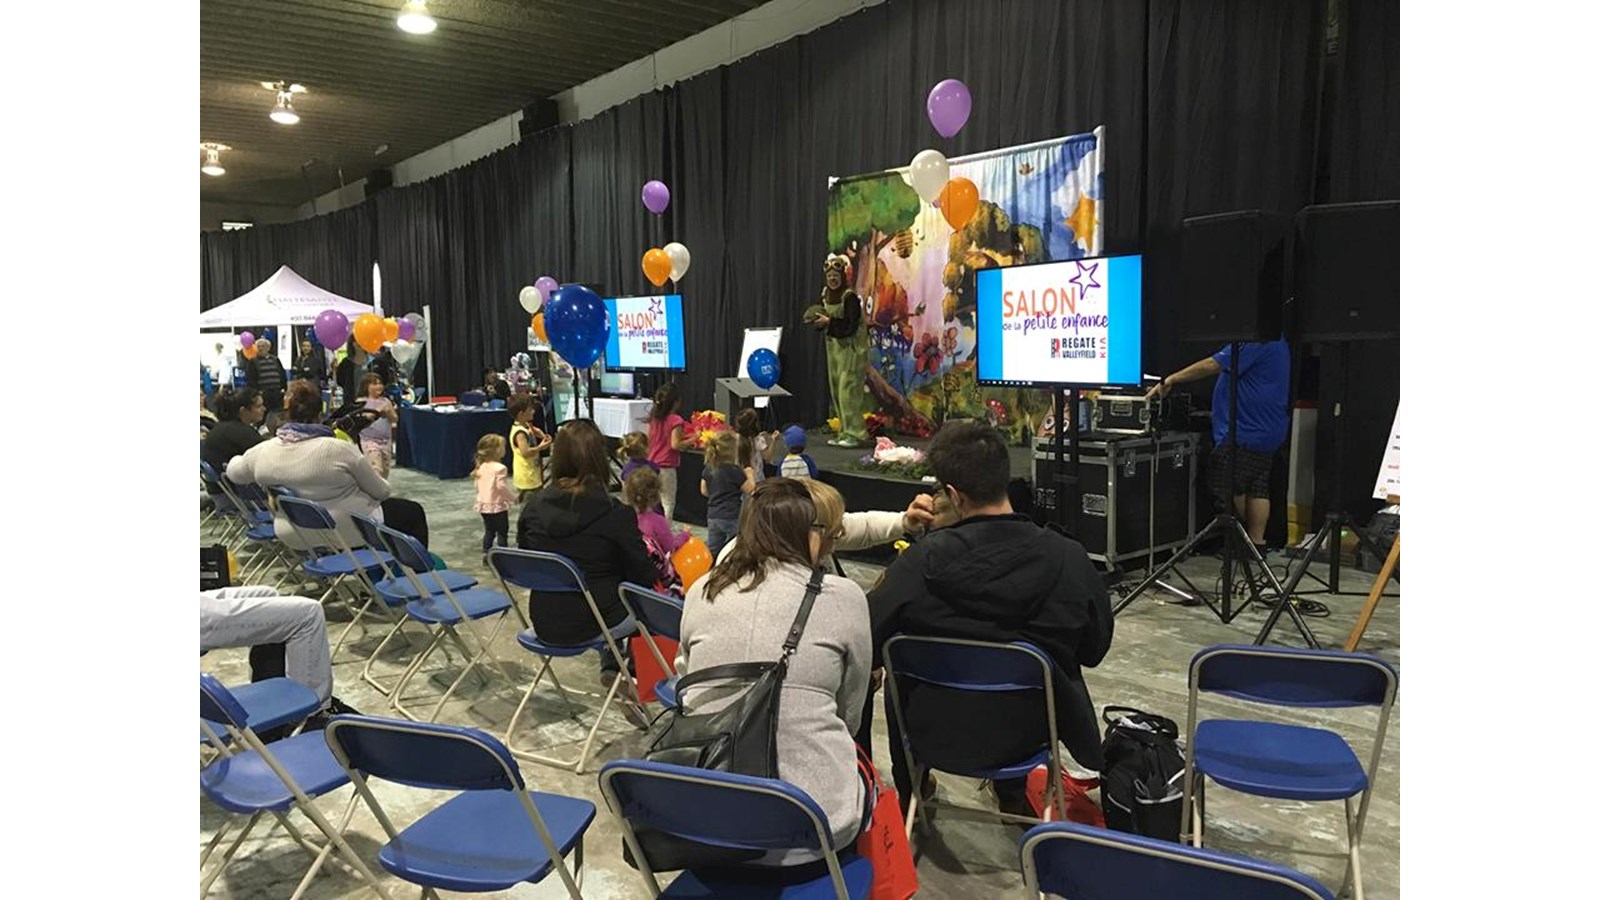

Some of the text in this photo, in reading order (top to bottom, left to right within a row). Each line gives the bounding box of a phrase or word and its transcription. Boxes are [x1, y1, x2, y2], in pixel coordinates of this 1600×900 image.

[1003, 287, 1076, 318] SALON
[617, 312, 653, 330] SALON
[1002, 312, 1108, 335] de la petite enfance
[1062, 337, 1096, 349] REGATE
[1062, 350, 1096, 359] VALLEYFIELD
